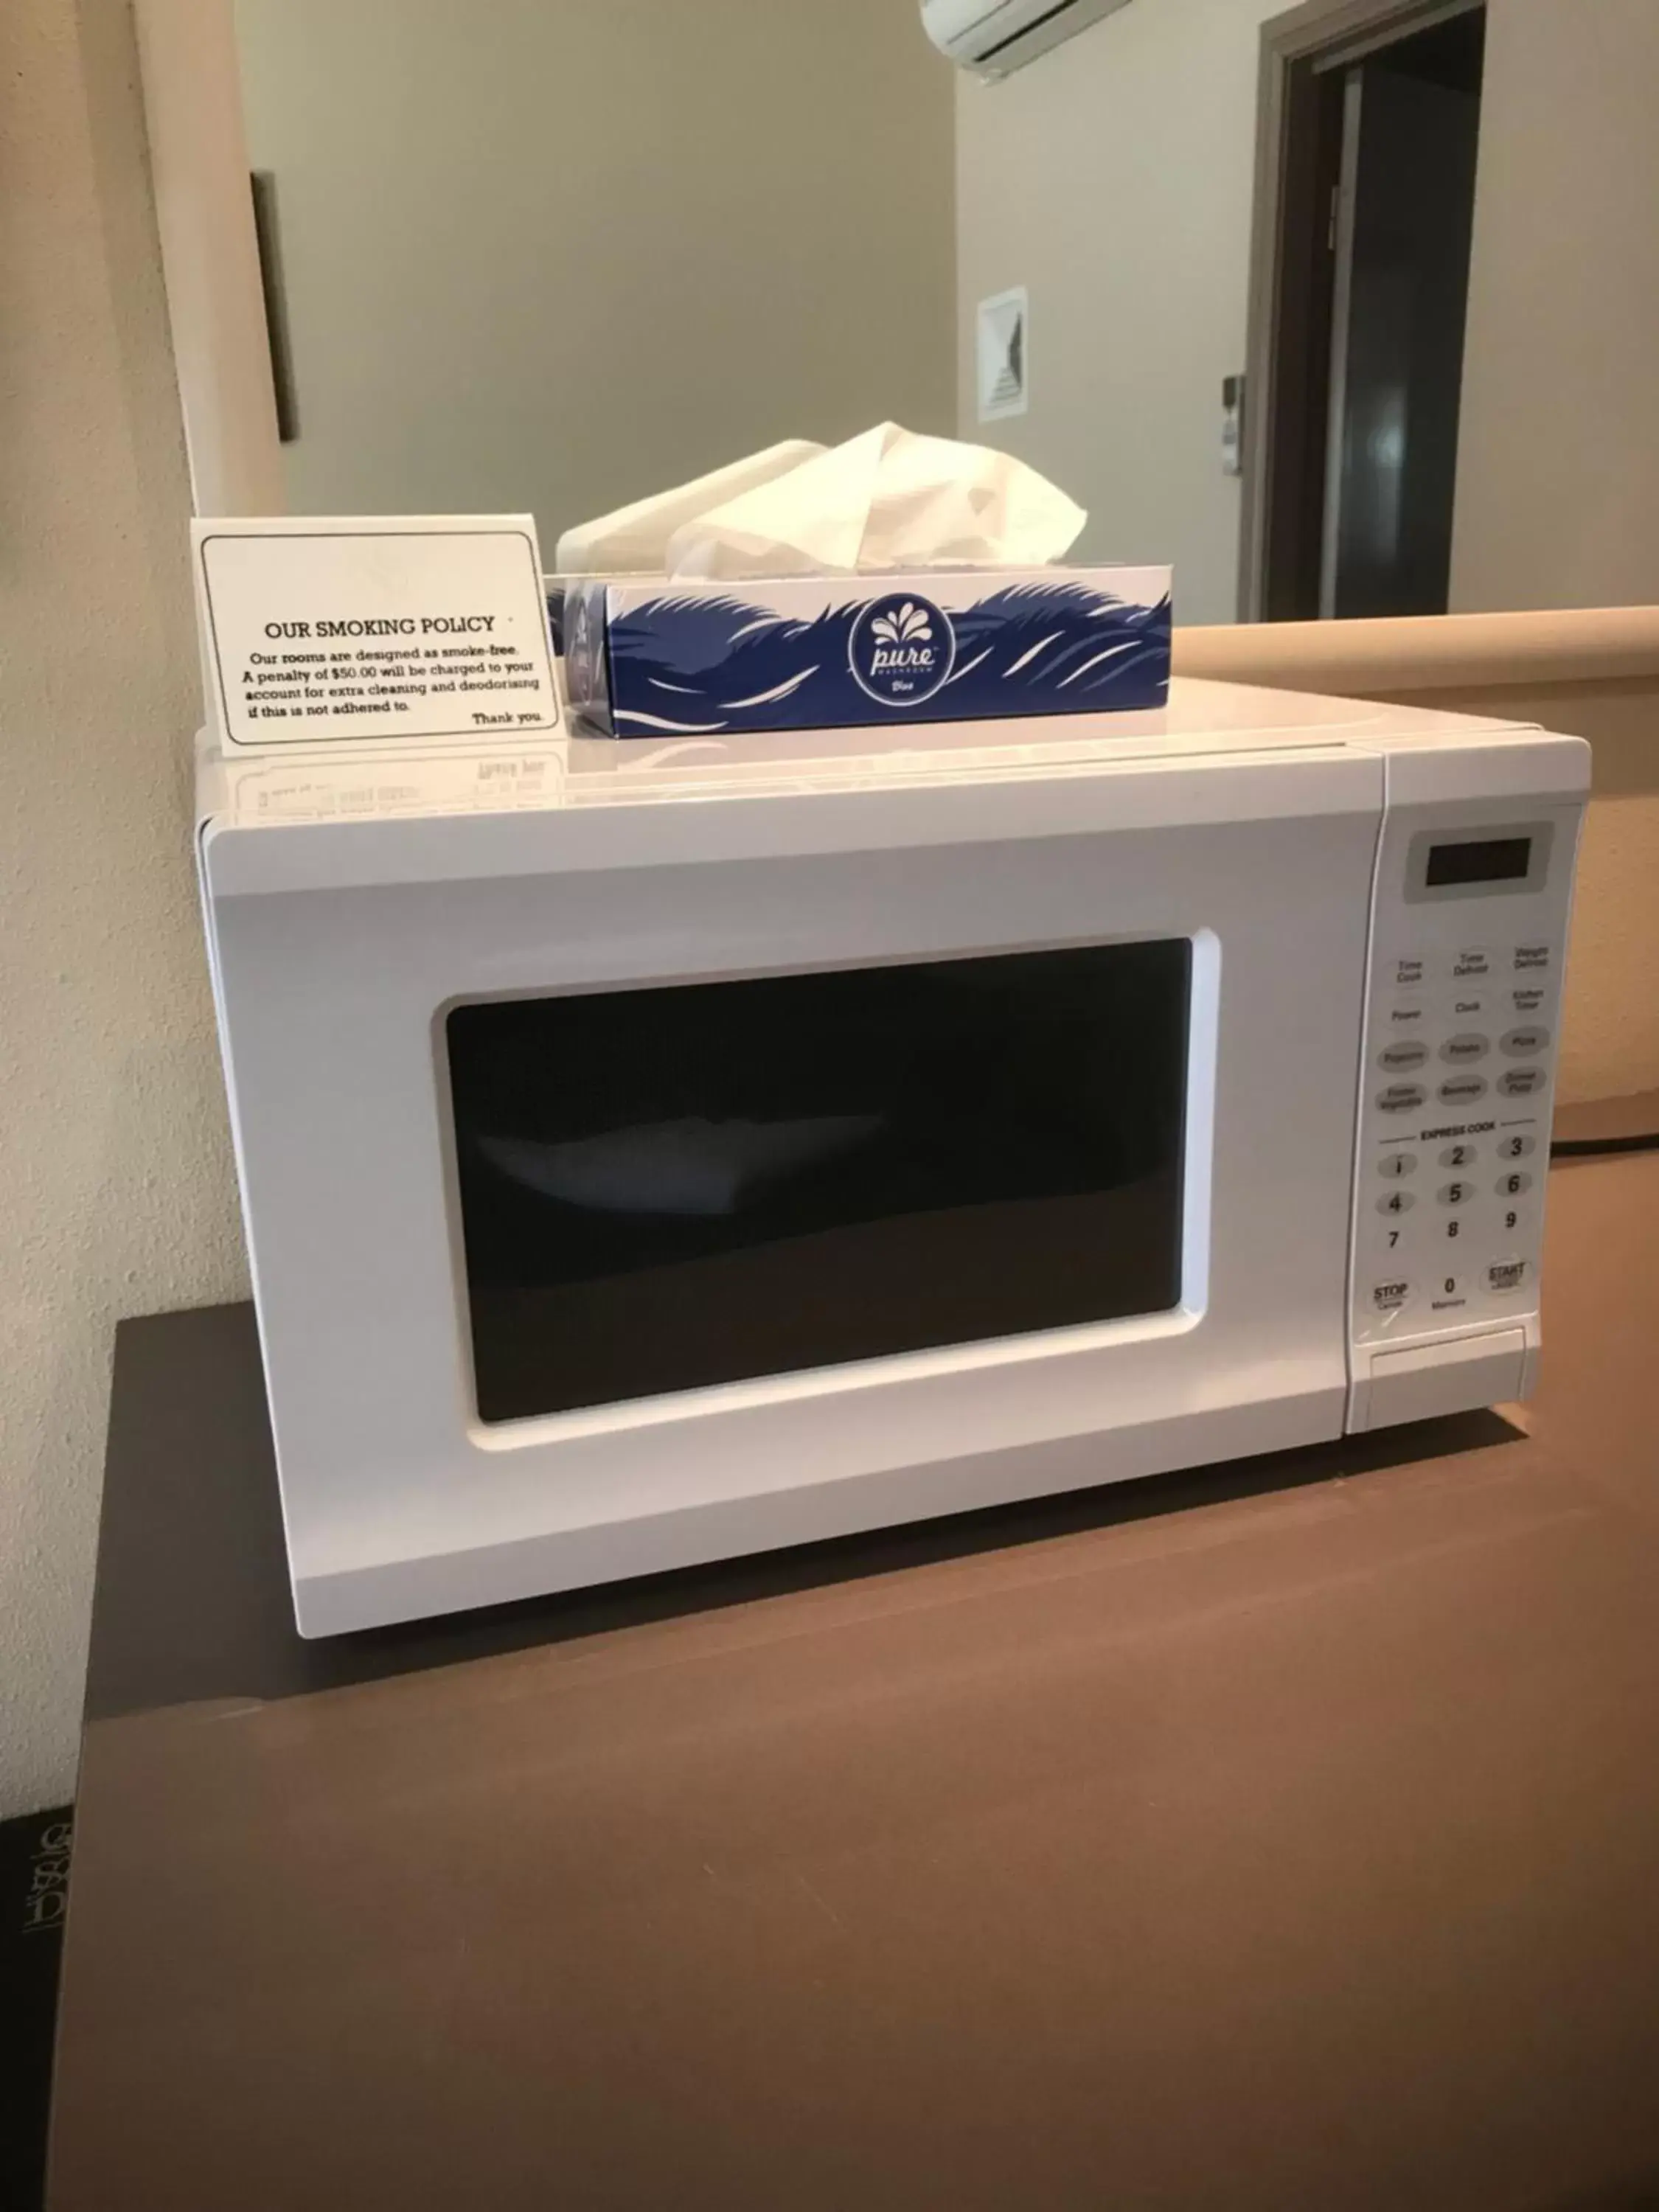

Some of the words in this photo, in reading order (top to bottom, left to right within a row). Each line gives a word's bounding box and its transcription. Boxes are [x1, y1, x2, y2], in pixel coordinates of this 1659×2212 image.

[265, 622, 311, 639] OUR
[316, 619, 415, 637] SMOKING
[421, 616, 495, 634] POLICY
[249, 653, 277, 664] Our
[282, 653, 326, 664] rooms
[330, 653, 352, 662] are
[355, 648, 420, 662] designed
[424, 650, 439, 658] as
[870, 647, 936, 677] pure
[242, 671, 254, 683] A
[257, 669, 310, 685] penalty
[315, 669, 329, 680] of
[332, 667, 377, 680] $50.00
[380, 665, 405, 678] will
[408, 665, 426, 676] be
[430, 663, 486, 677] charged
[490, 663, 501, 672] to
[504, 662, 534, 675] your
[246, 688, 302, 700] account
[305, 686, 324, 698] for
[329, 686, 364, 697] extra
[368, 684, 427, 695] cleaning
[431, 681, 456, 692] and
[459, 678, 540, 691] deodorising
[248, 706, 258, 718] if
[261, 706, 288, 717] this
[291, 706, 302, 716] is
[307, 705, 328, 715] not
[333, 701, 391, 714] adhered
[472, 712, 513, 724] Thank
[1420, 1125, 1466, 1141] EXPRESS
[1467, 1121, 1496, 1134] COOK
[1451, 1146, 1464, 1166] 2
[1510, 1137, 1523, 1156] 3
[1450, 1183, 1462, 1203] 5
[1507, 1175, 1521, 1194] 6
[1388, 1193, 1402, 1212] 4
[1506, 1211, 1517, 1228] 9
[1447, 1221, 1459, 1238] 8
[1388, 1231, 1400, 1248] 7
[1374, 1282, 1408, 1300] STOP
[1444, 1277, 1455, 1293] 0
